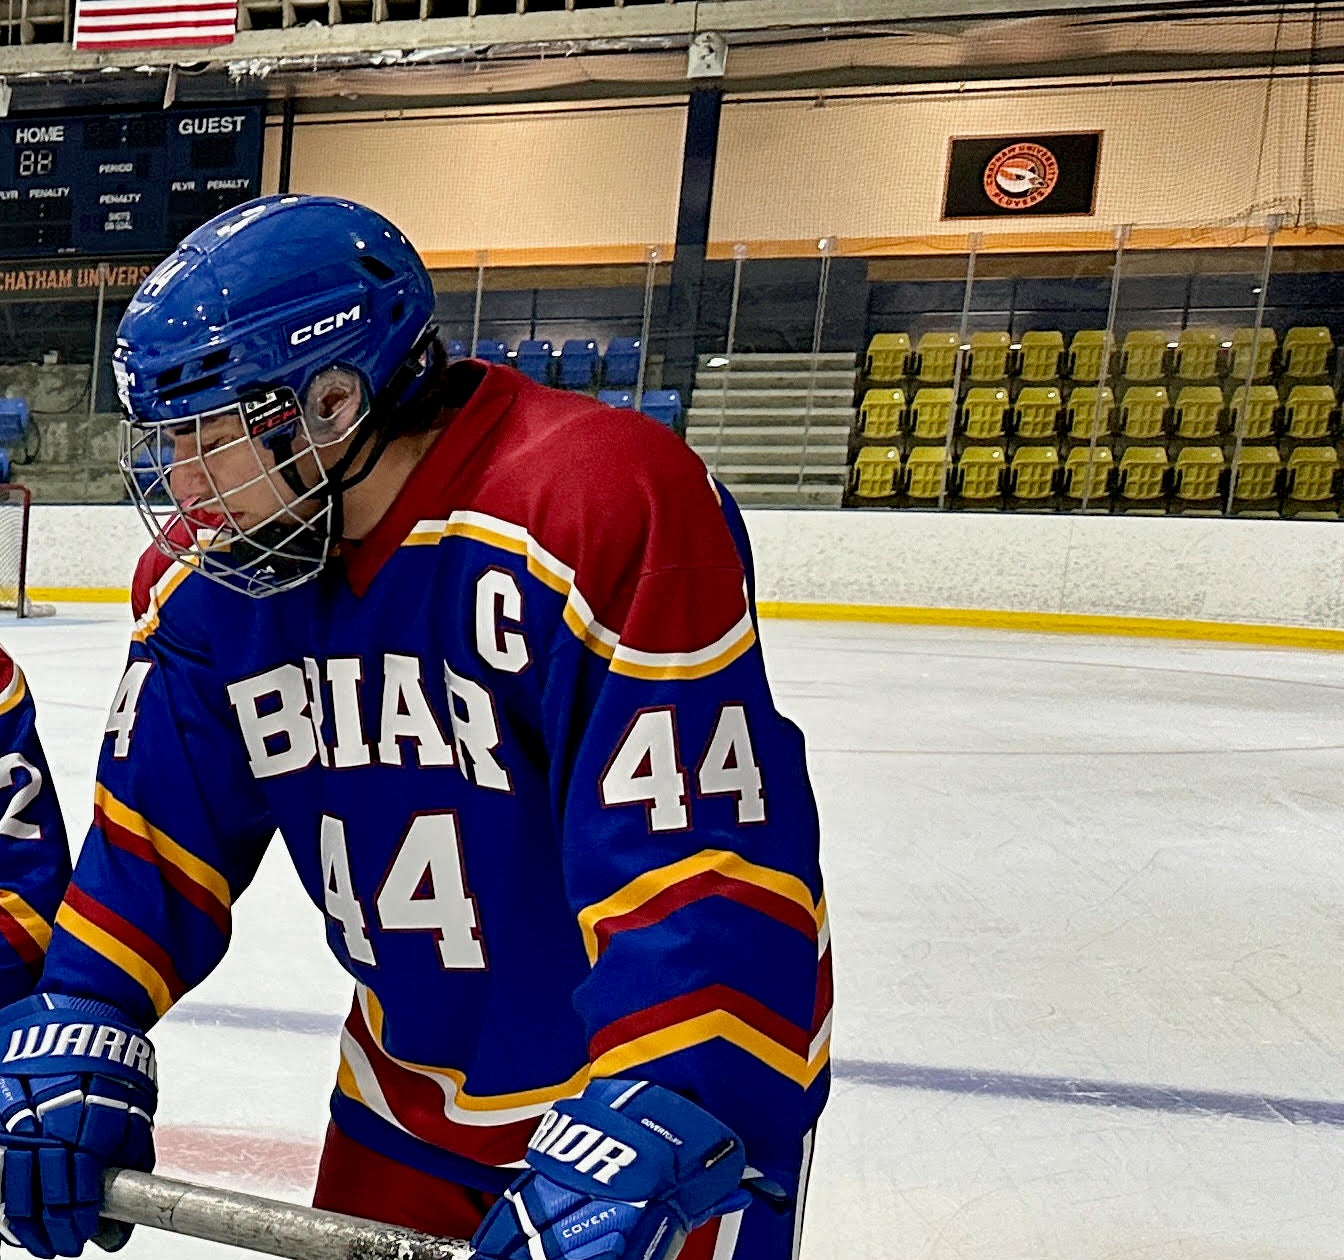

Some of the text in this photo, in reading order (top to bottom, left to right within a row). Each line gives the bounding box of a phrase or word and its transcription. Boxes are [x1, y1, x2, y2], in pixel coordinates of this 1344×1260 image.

[15, 125, 64, 144] HOME
[178, 116, 246, 135] GUEST
[99, 163, 133, 174] PERIOD
[29, 187, 70, 199] PENALTY
[207, 178, 250, 190] PENALTY
[99, 193, 141, 204] PENALTY
[77, 265, 155, 289] UNVERS
[290, 304, 361, 347] CCM
[475, 568, 530, 673] C
[599, 705, 766, 831] 44
[320, 812, 486, 969] 44
[561, 1206, 617, 1239] COVERT
